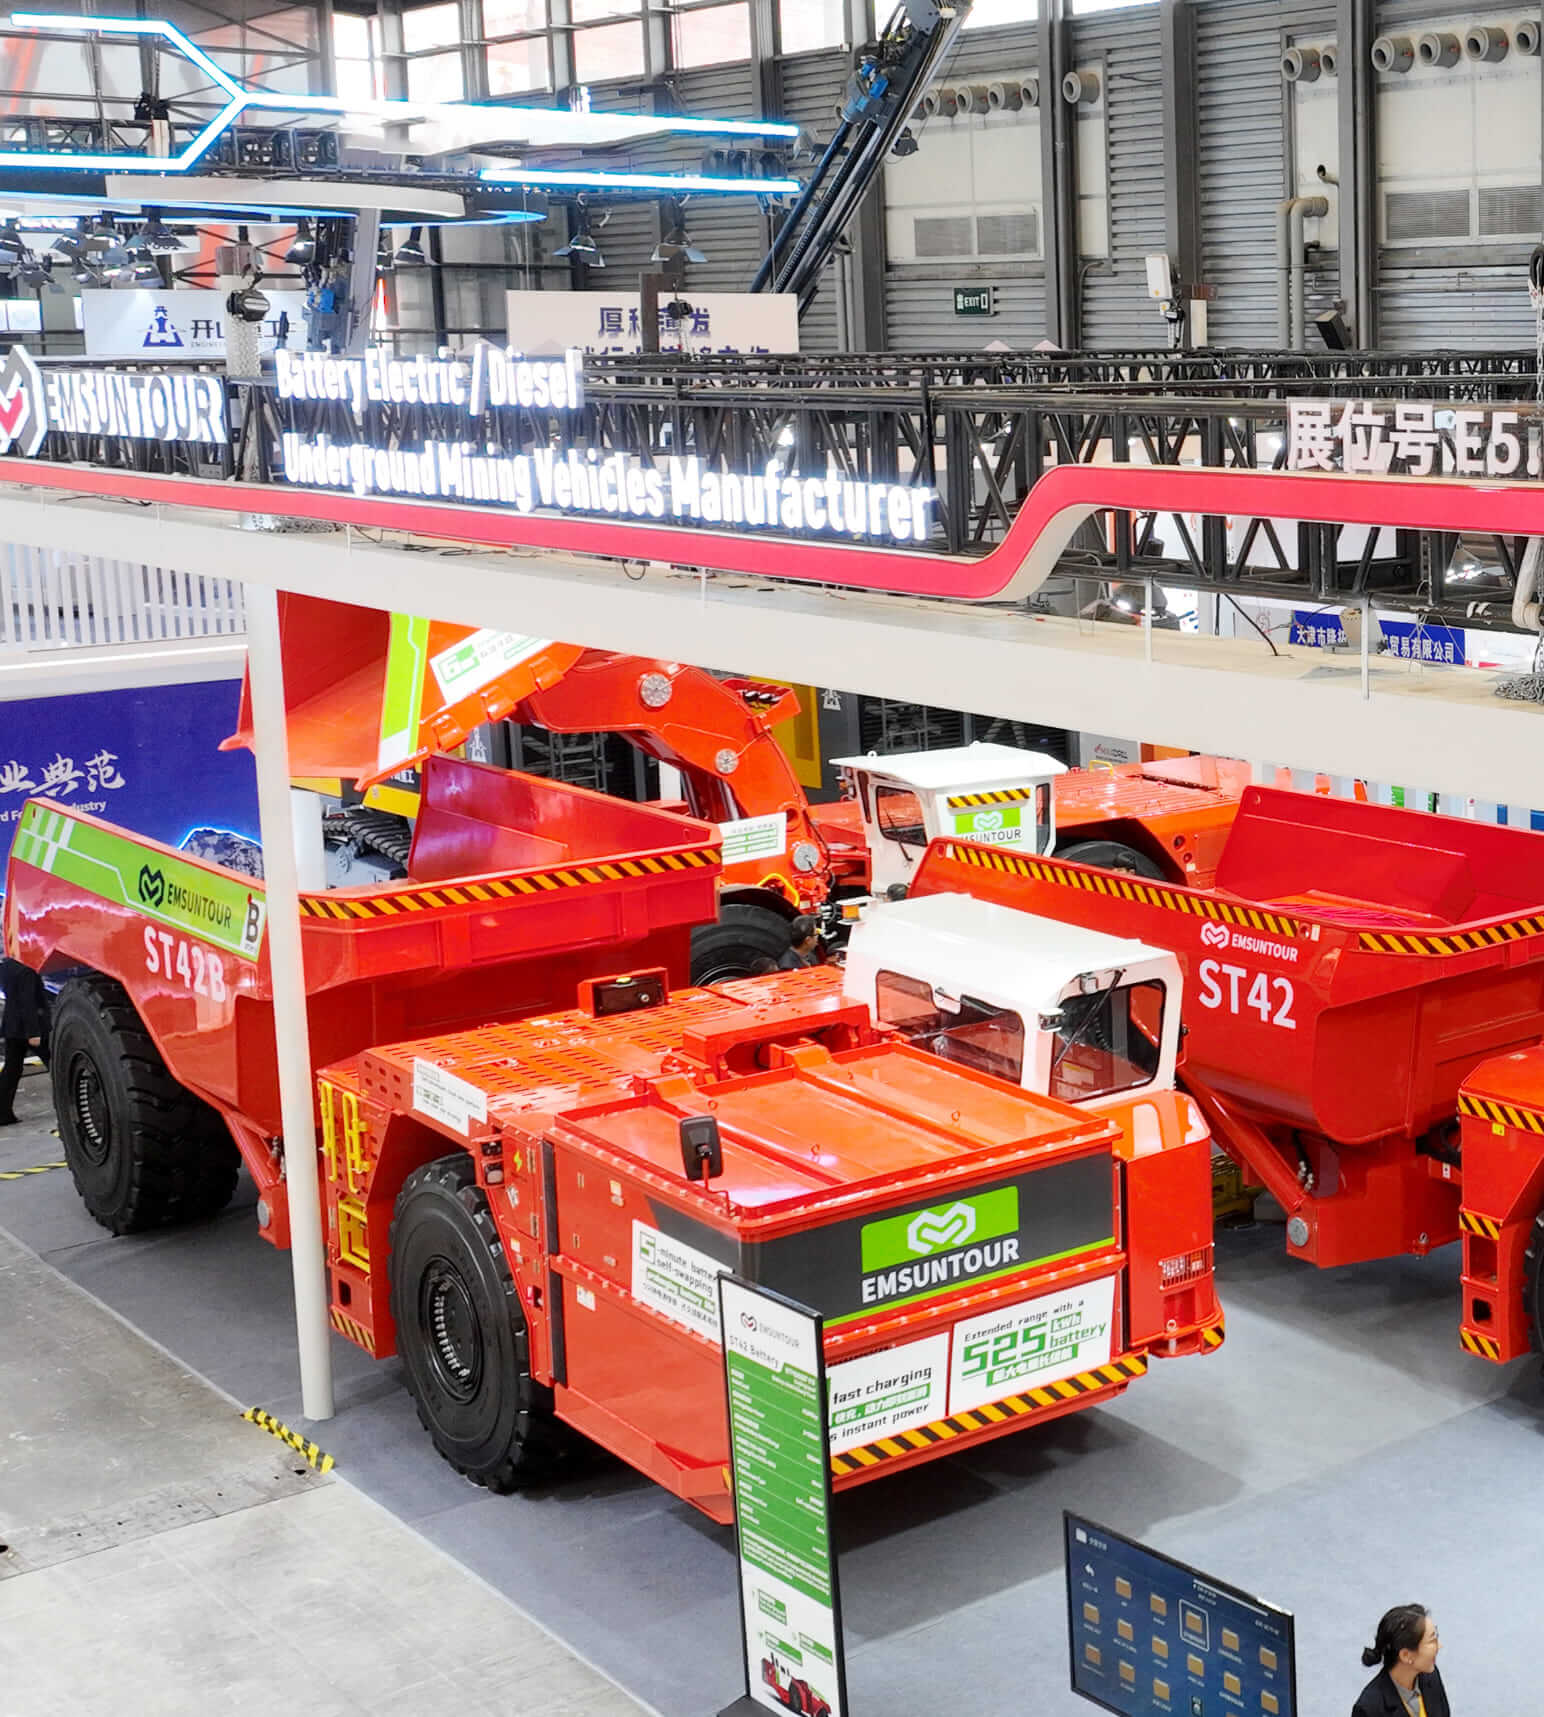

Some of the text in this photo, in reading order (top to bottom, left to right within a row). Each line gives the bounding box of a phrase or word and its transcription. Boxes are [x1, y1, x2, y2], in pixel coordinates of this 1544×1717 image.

[964, 296, 980, 307] EXIT
[275, 348, 366, 413] Battery
[366, 345, 468, 405] Electric
[488, 347, 585, 409] Diesel
[47, 371, 228, 443] EMSUNTOUR
[283, 432, 940, 541] Underground Mining Vehicles Manufacturer
[167, 883, 232, 928] EMSUNTOUR
[246, 901, 260, 943] B
[143, 925, 226, 1003] ST42B
[1231, 933, 1298, 962] EMSUNTOUR
[1199, 959, 1297, 1030] ST42
[861, 1238, 1020, 1304] EMSUNTOUR
[961, 1322, 1048, 1377] 525
[964, 1320, 1013, 1343] Extended
[1018, 1311, 1048, 1326] range
[1051, 1323, 1107, 1349] battery
[866, 1367, 932, 1395] charging
[842, 1416, 887, 1438] instant
[893, 1404, 929, 1424] power
